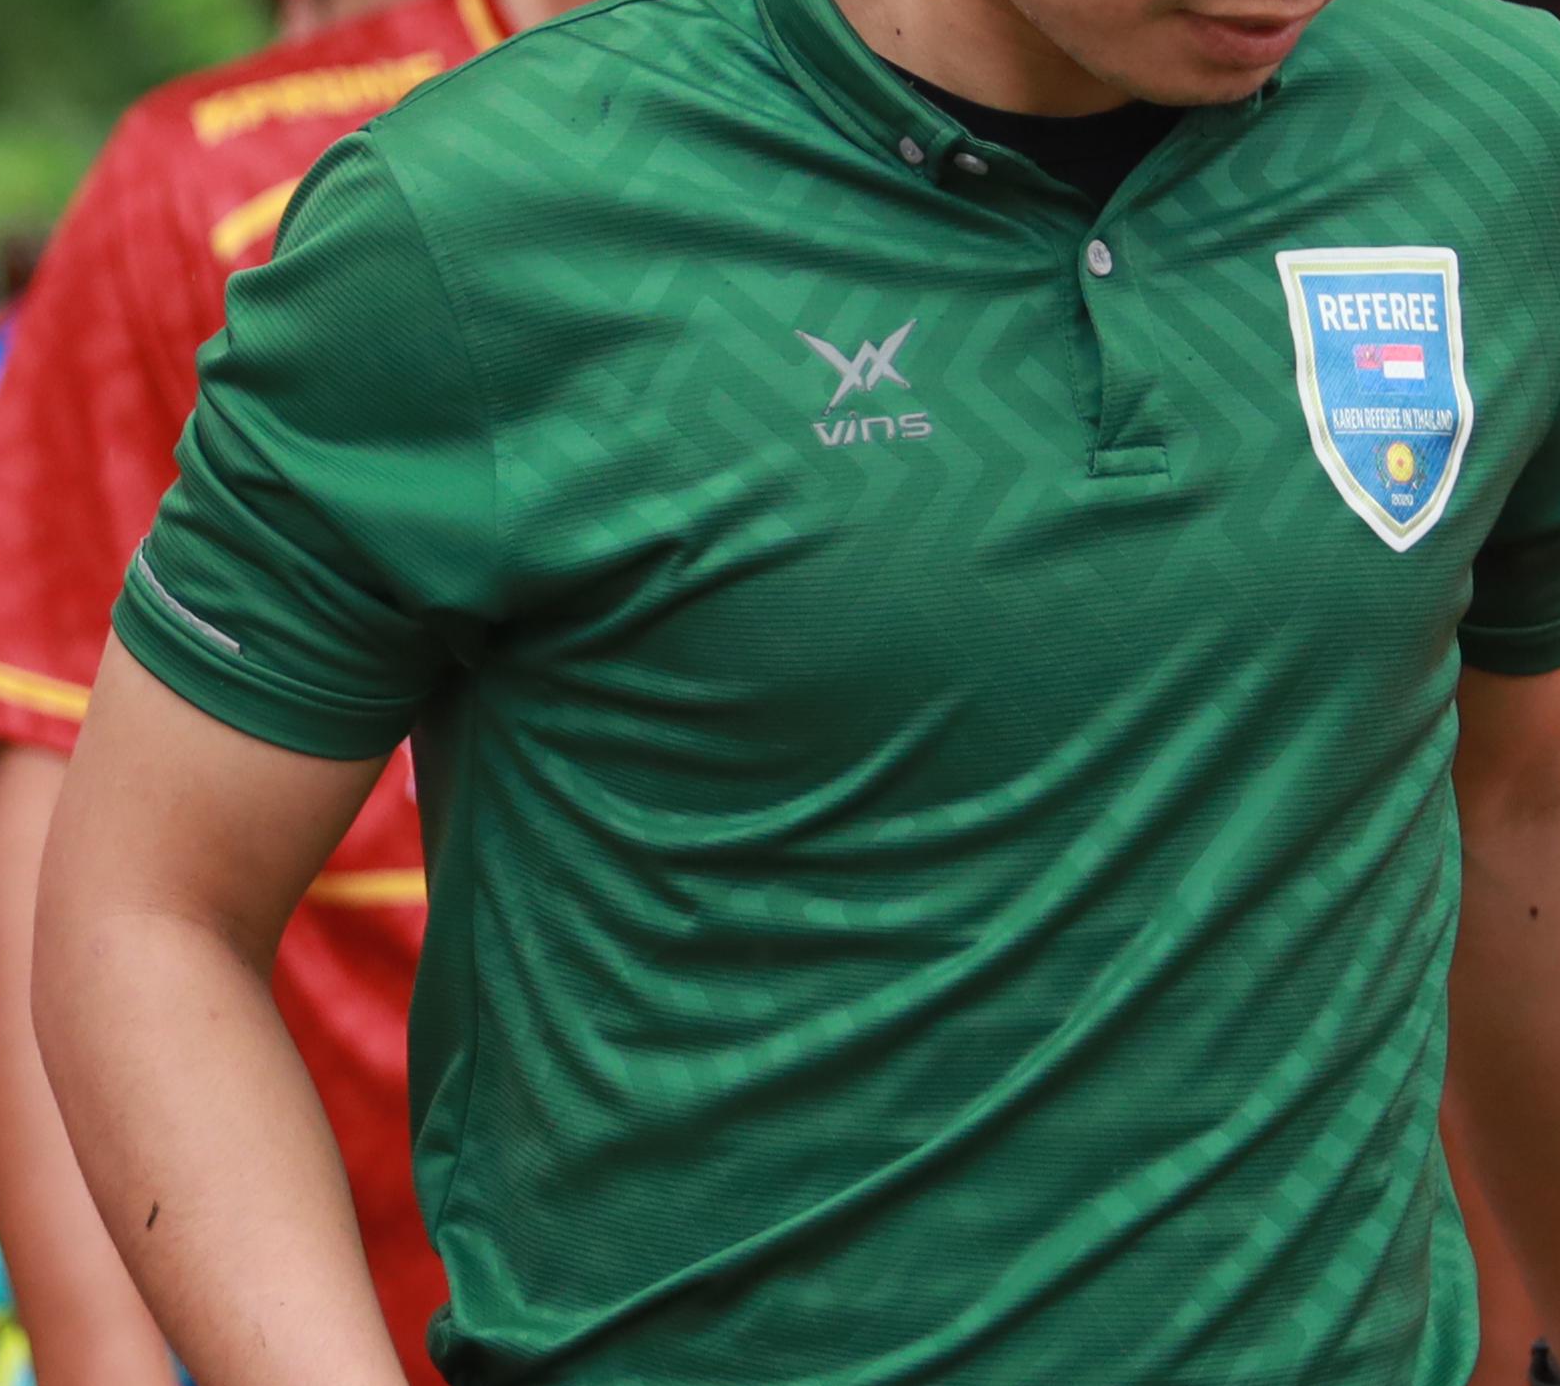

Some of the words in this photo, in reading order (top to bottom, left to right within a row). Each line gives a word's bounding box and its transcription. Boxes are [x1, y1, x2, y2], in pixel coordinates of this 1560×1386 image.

[1317, 293, 1439, 331] REFEREE
[1332, 407, 1363, 429] KAREN
[1365, 407, 1402, 429] REFEREE
[1403, 408, 1412, 428] IN
[1413, 408, 1453, 430] THAILAND
